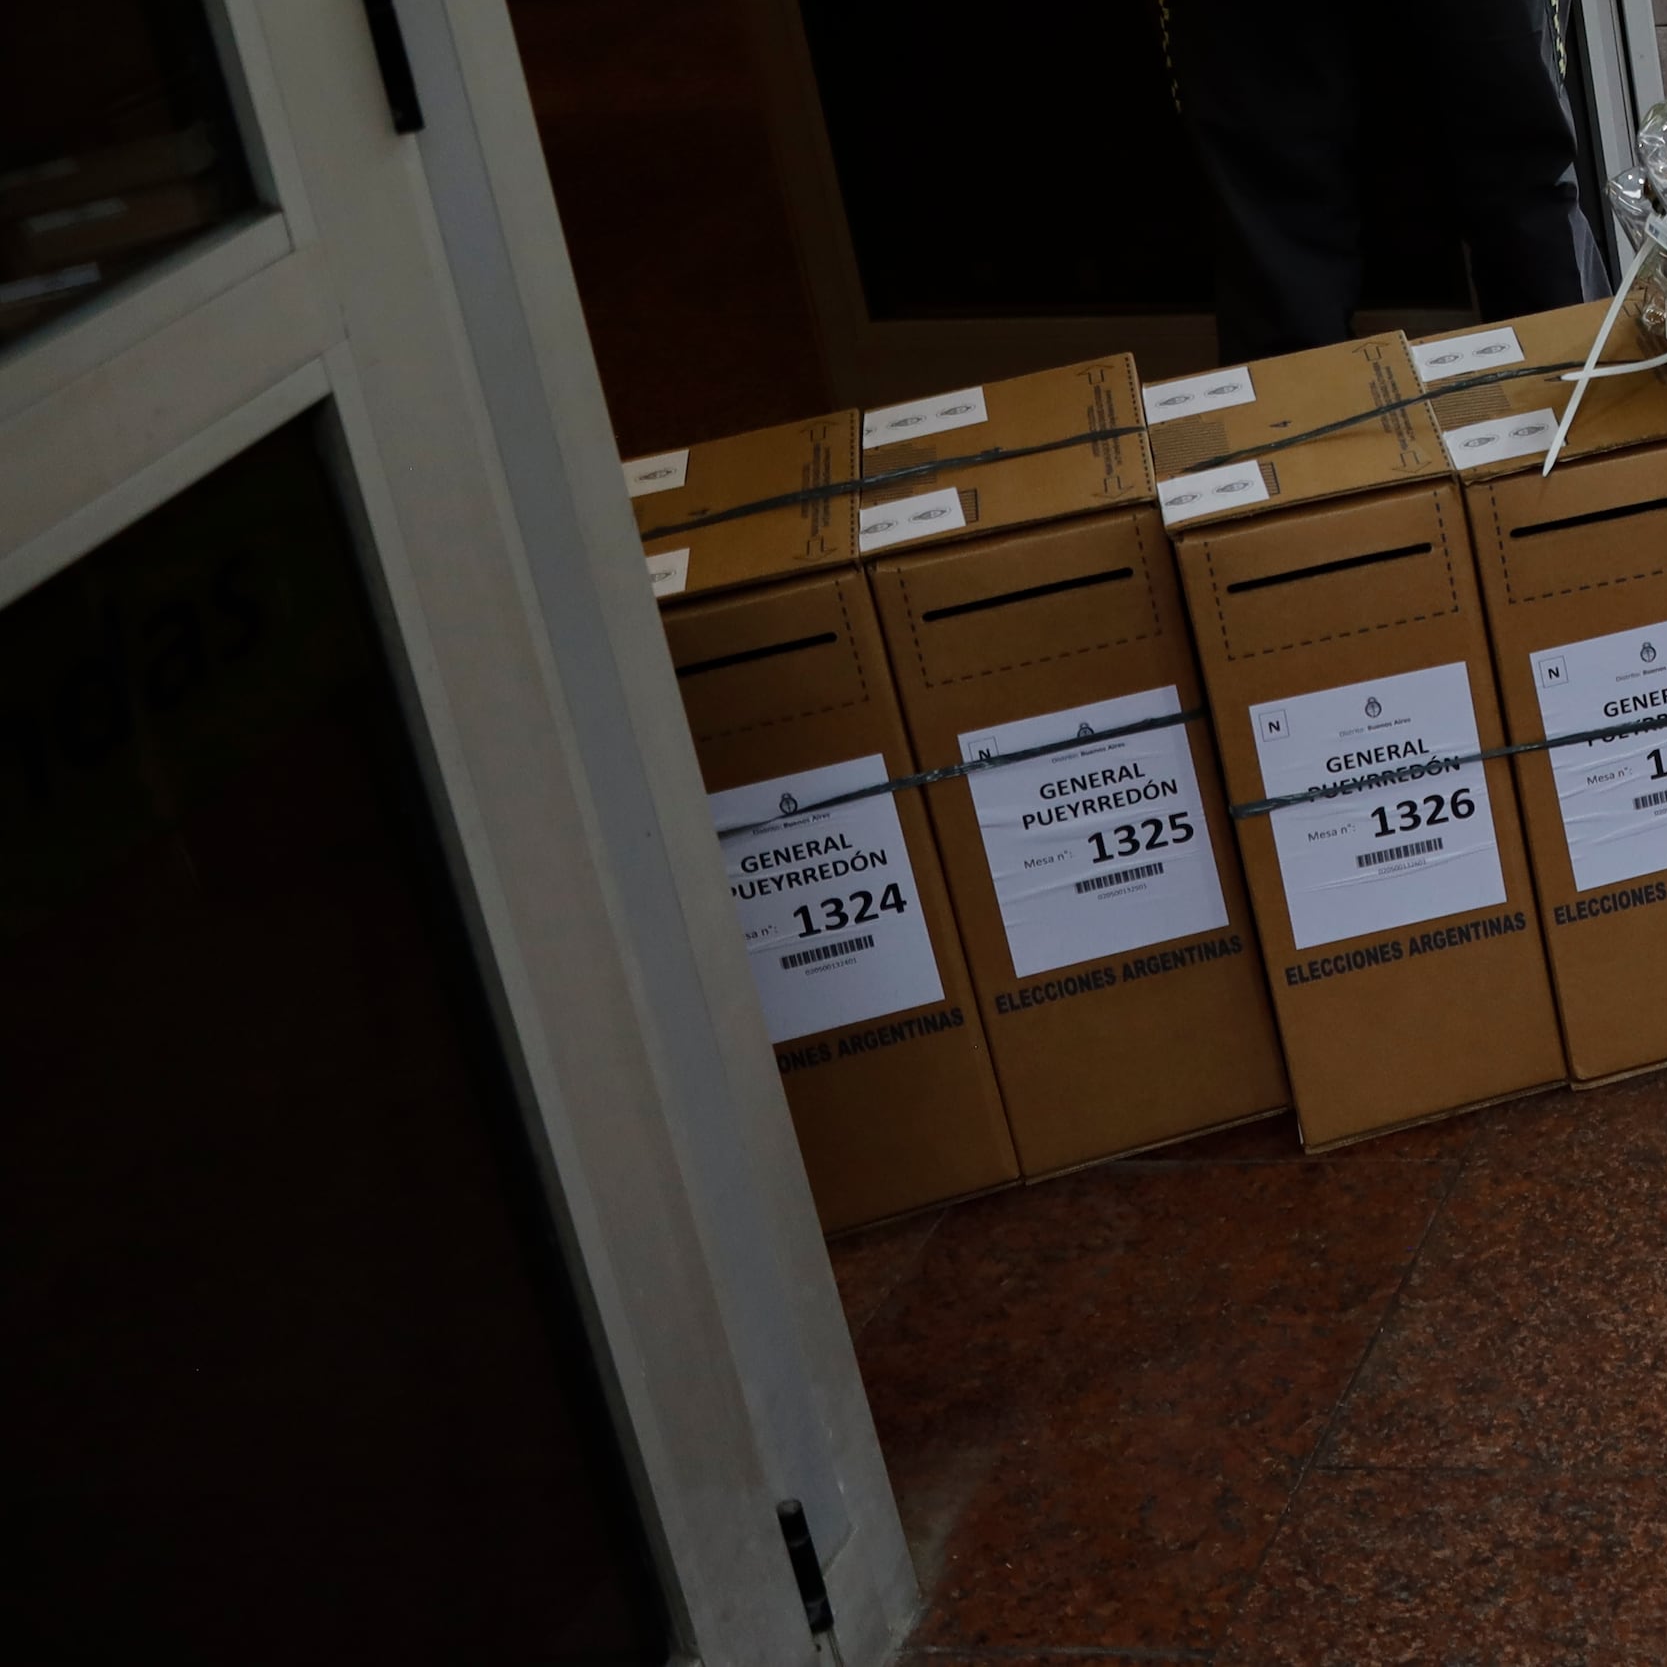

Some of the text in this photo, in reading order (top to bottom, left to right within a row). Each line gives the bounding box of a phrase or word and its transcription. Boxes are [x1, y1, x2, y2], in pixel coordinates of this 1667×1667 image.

[1547, 666, 1560, 680] N
[1267, 719, 1281, 733] N
[977, 747, 991, 760] N
[1324, 736, 1430, 774] GENERAL
[1037, 760, 1146, 801] GENERAL
[1585, 770, 1615, 786] Mesa
[1020, 774, 1179, 831] PUEYRREDÓN
[1307, 826, 1337, 842] Mesa
[1368, 786, 1477, 839] 1326
[738, 831, 853, 875] GENERAL
[1022, 853, 1055, 870] Mesa
[1085, 809, 1196, 864] 1325
[729, 845, 889, 903] UEYRREDÓN
[790, 880, 910, 939] 1324
[1554, 882, 1667, 926] ELECCIONES
[1285, 912, 1526, 987] ELECCIONES ARGENTINAS
[995, 935, 1243, 1015] ELECCIONES ARGENTINAS
[838, 1007, 964, 1057] ARGENTINAS
